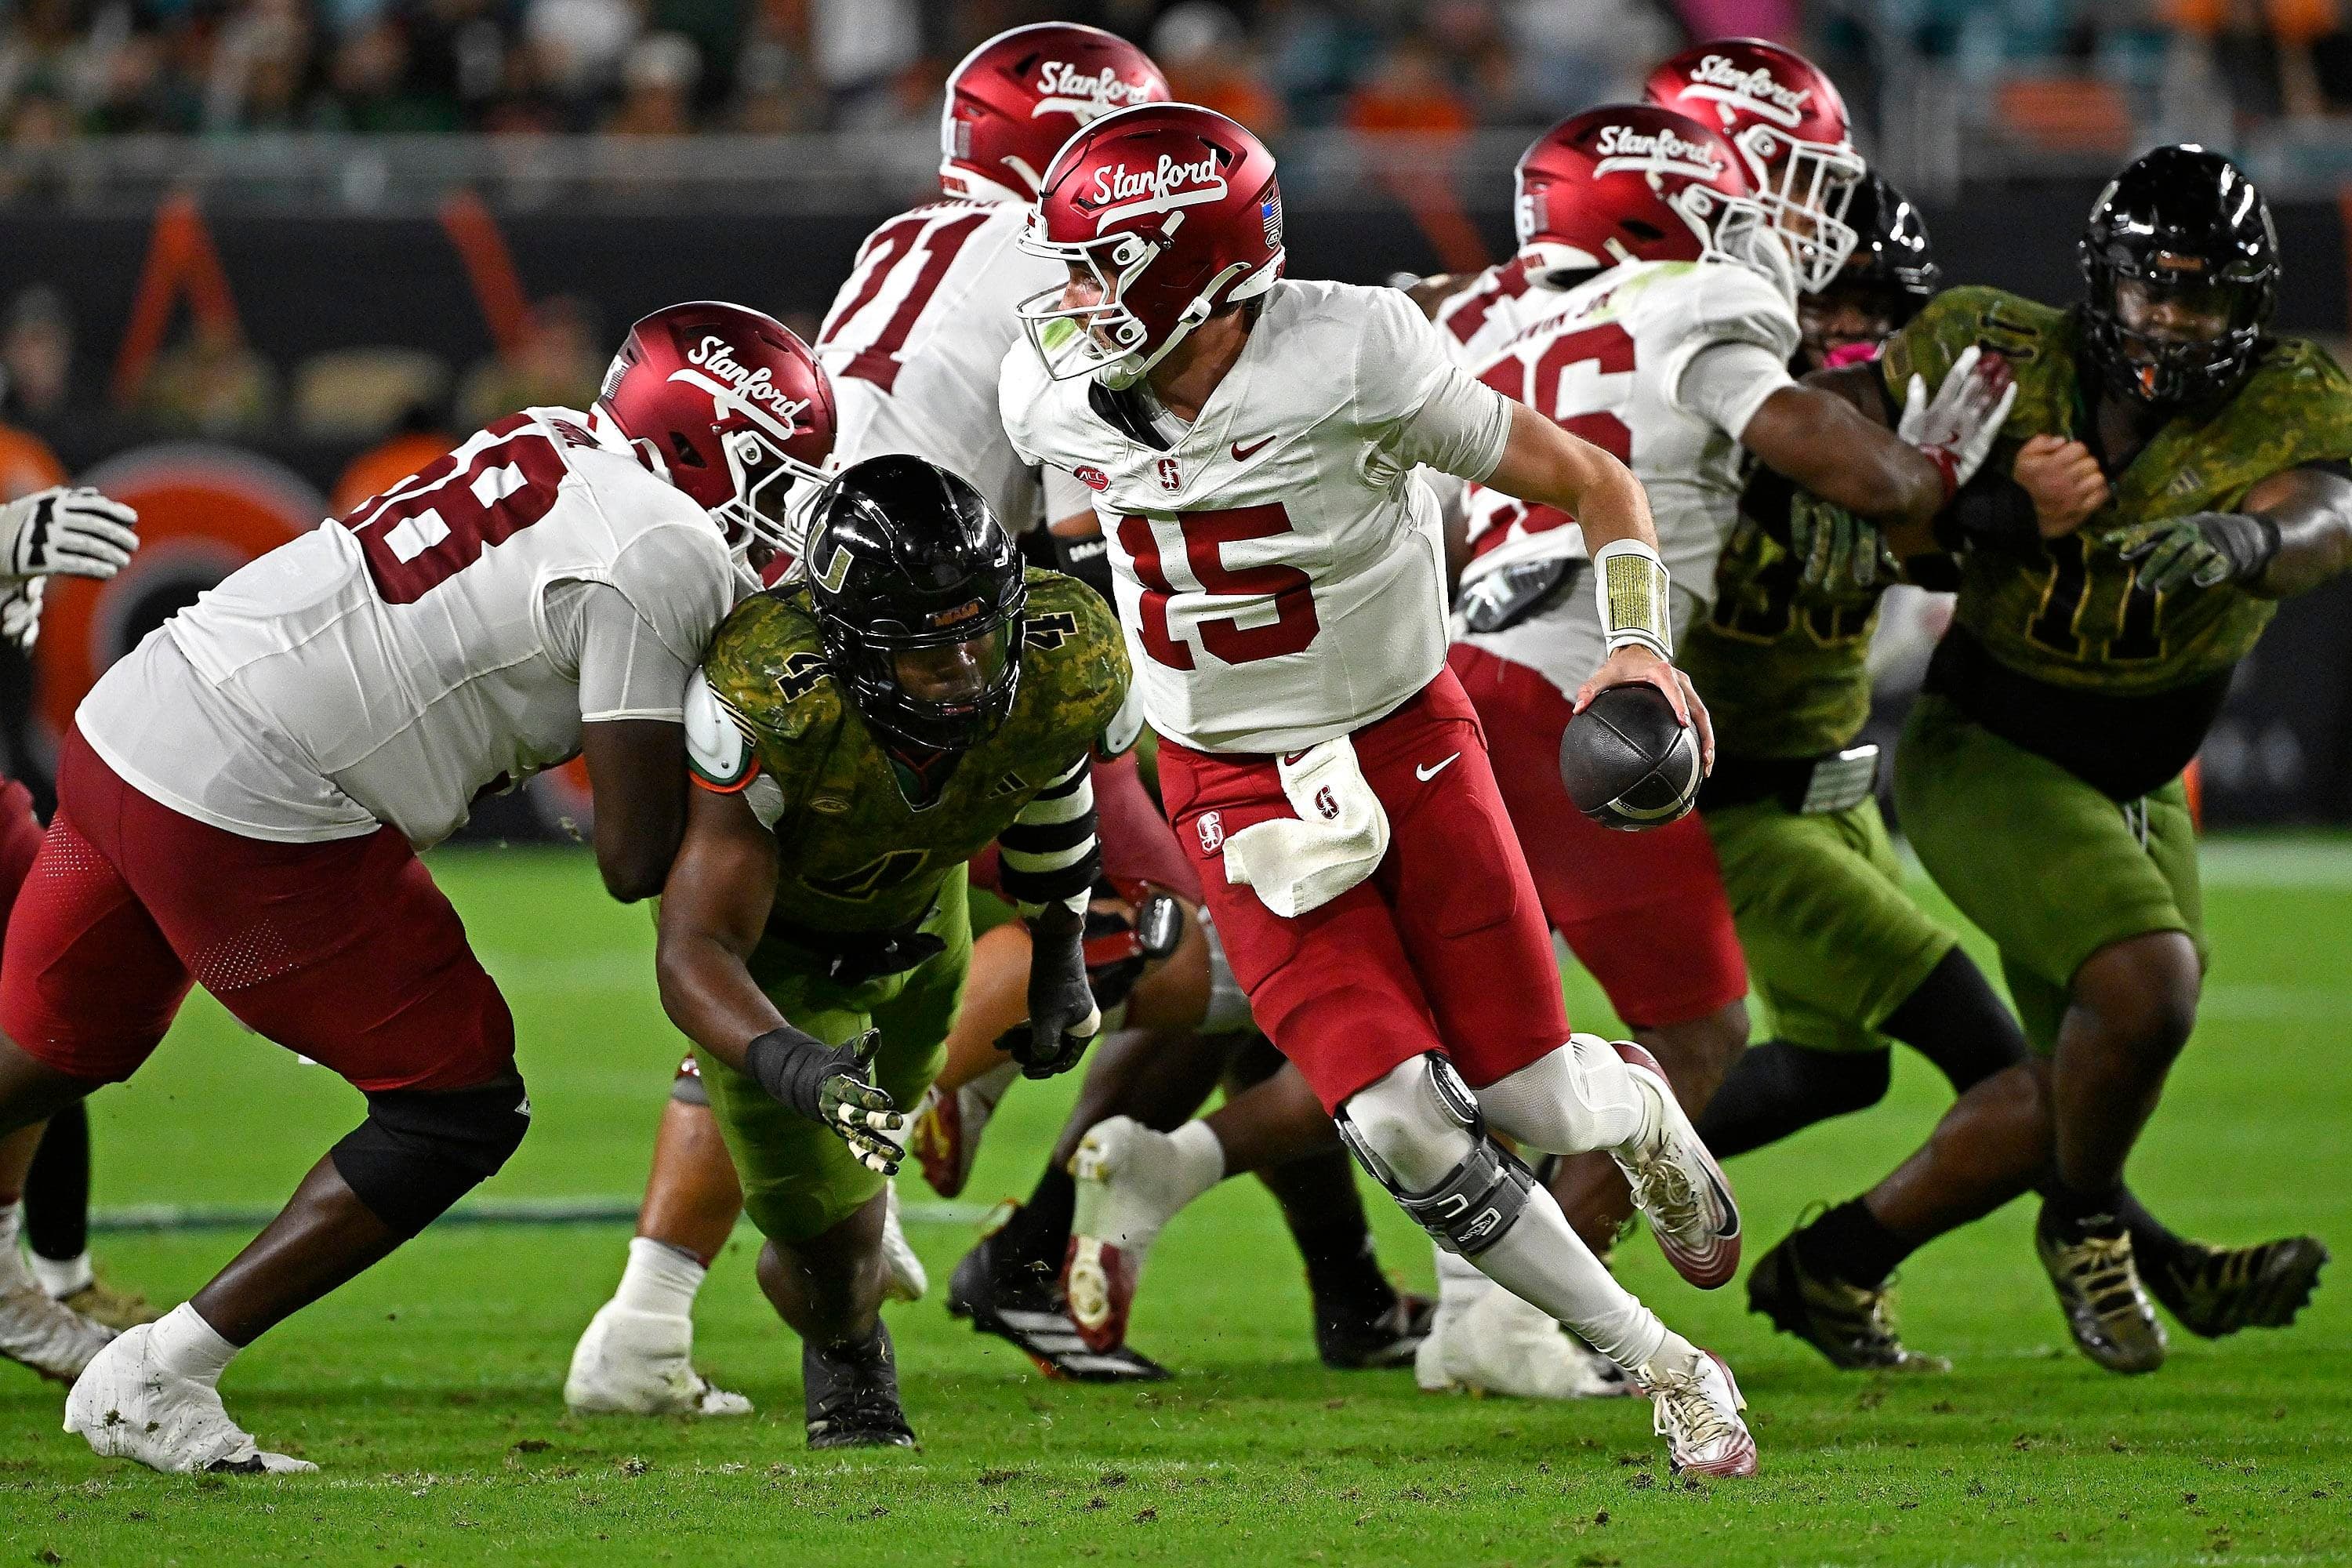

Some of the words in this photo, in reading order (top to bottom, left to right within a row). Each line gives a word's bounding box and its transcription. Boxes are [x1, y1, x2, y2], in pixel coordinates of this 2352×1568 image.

[1036, 61, 1152, 108] Stanford
[1689, 54, 1810, 114] Stanford
[1597, 125, 1723, 170] Stanford
[1093, 148, 1227, 213] Stanford
[688, 336, 811, 430] Stanford
[1079, 470, 1105, 484] ACC
[1116, 502, 1320, 671] 15
[1022, 611, 1079, 652] 4
